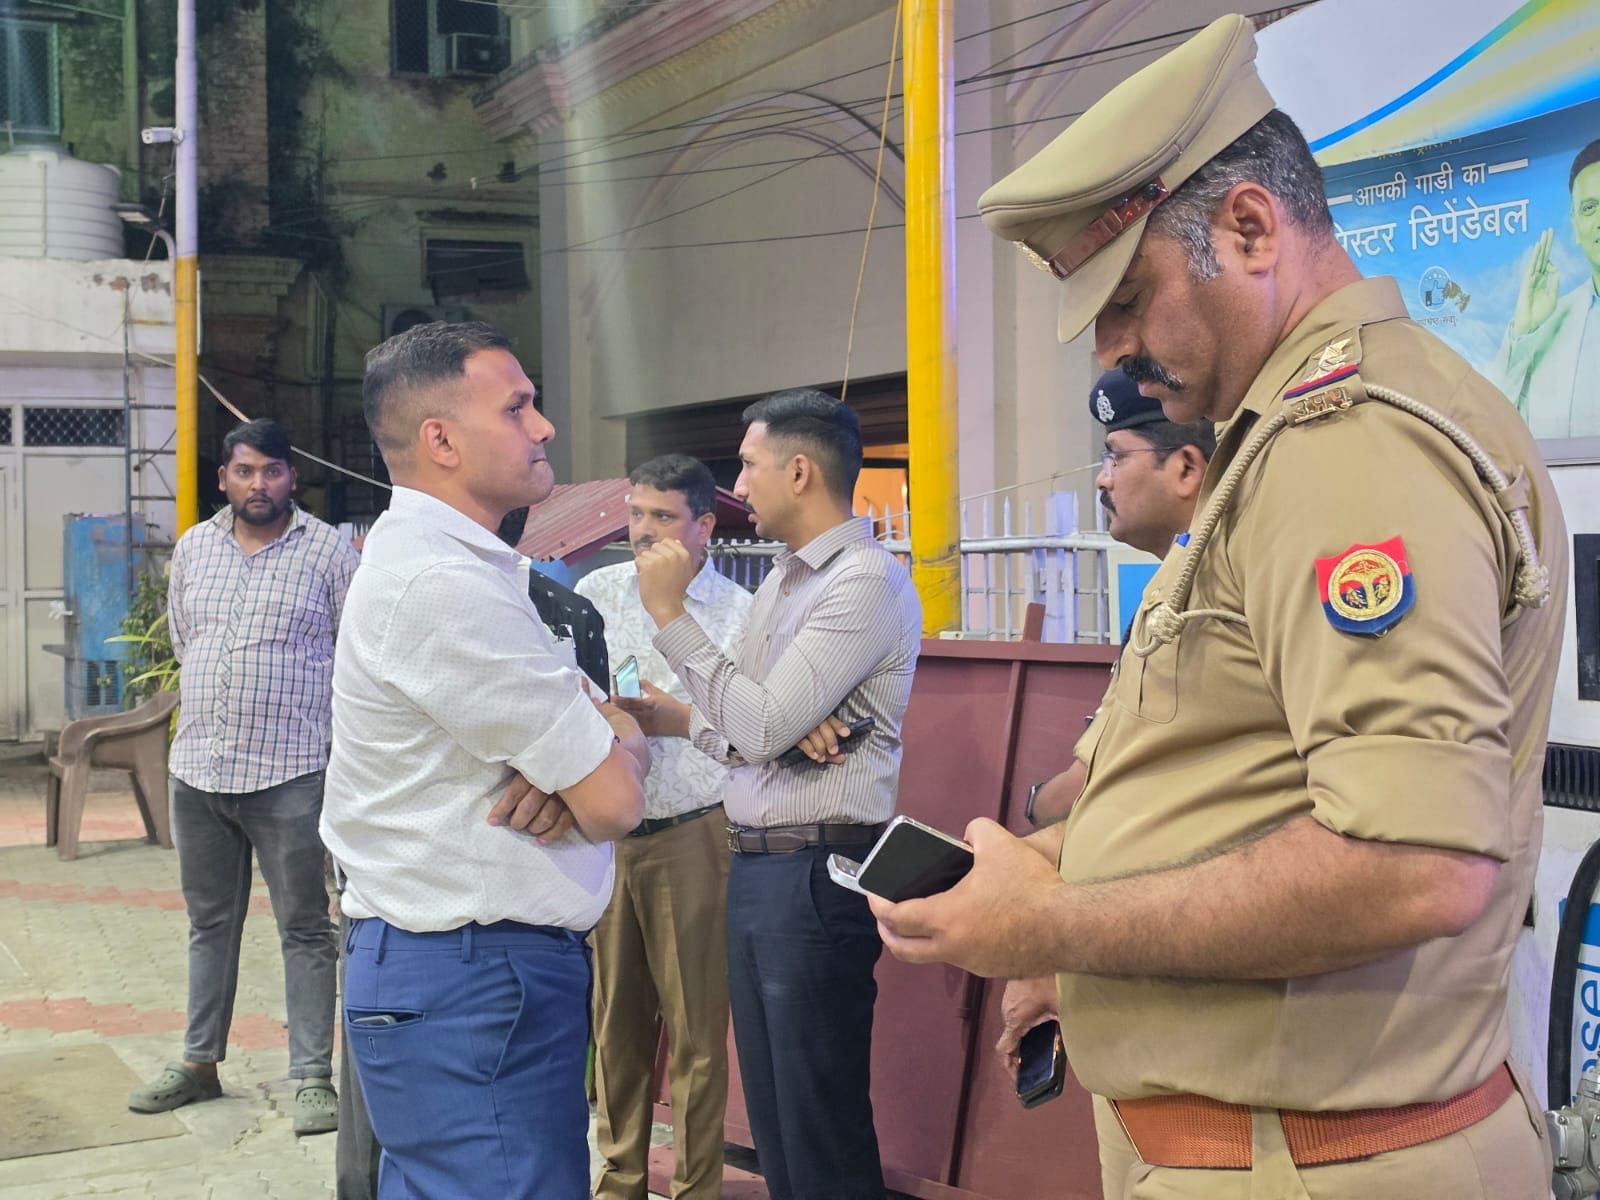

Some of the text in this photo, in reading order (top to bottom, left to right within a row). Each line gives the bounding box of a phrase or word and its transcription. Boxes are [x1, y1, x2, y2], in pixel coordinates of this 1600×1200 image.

[1355, 161, 1486, 206] आपकी गाड़ी का
[1409, 197, 1529, 250] डिपेंडेबल
